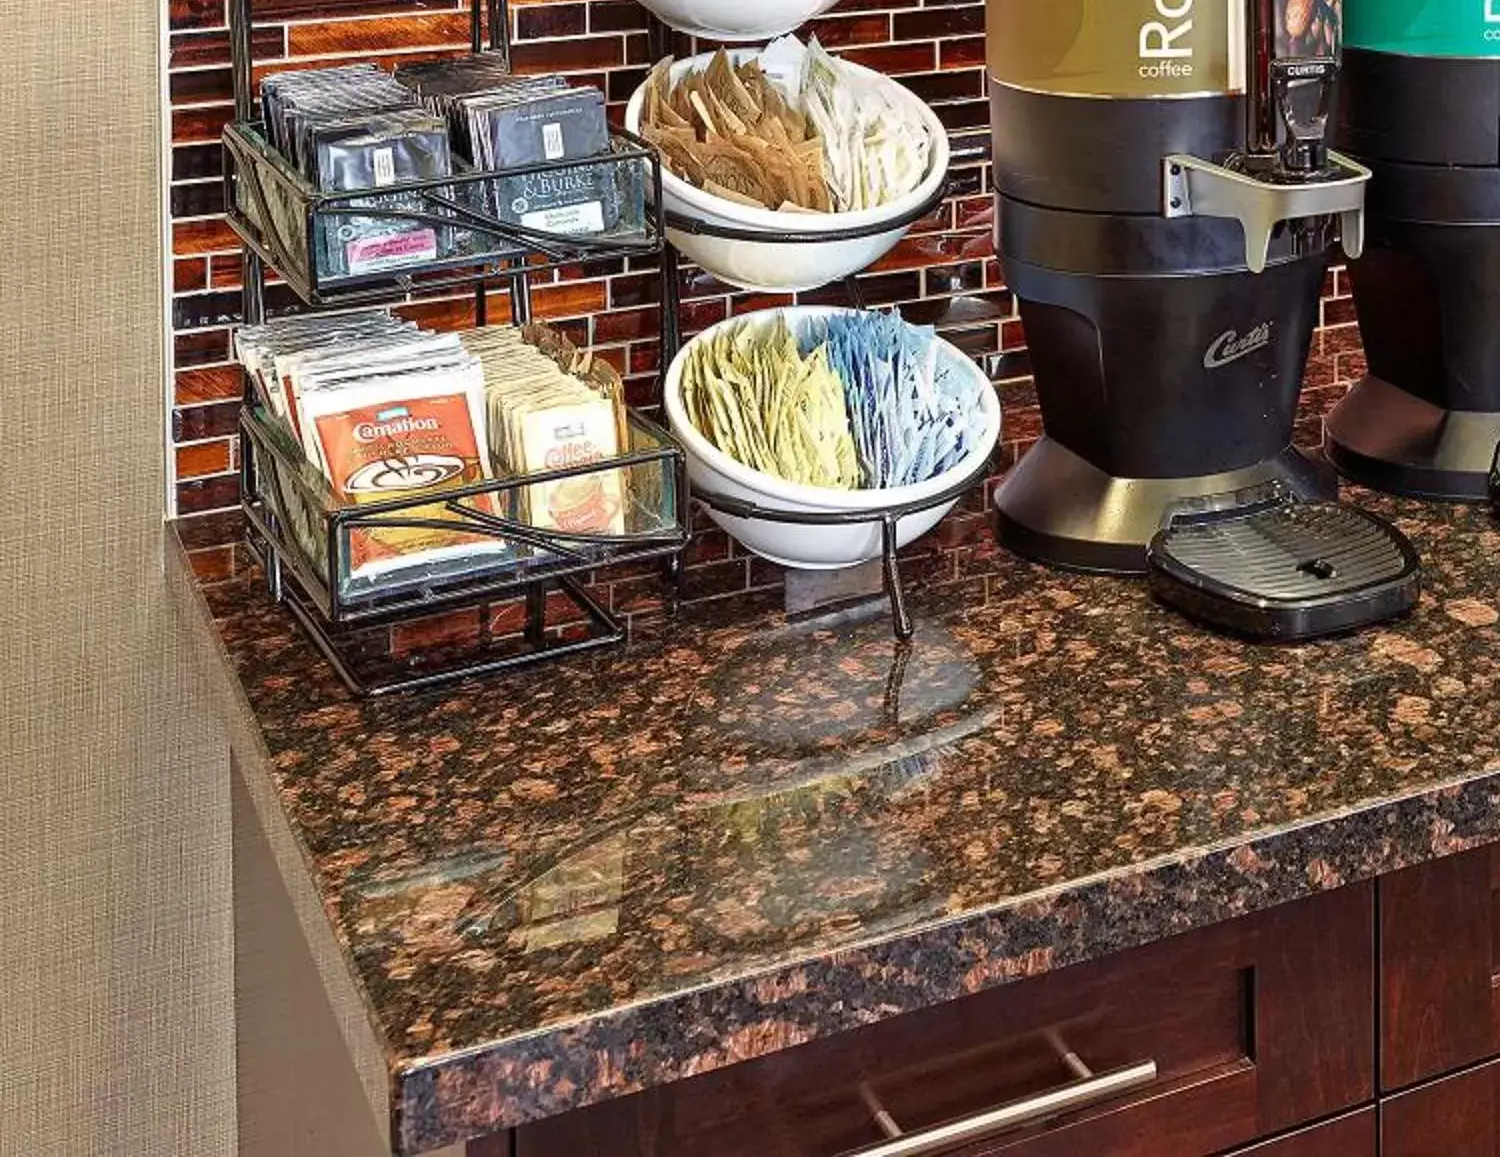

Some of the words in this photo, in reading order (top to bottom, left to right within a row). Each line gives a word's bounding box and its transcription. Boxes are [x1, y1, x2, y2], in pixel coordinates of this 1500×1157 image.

[1138, 59, 1194, 80] coffee
[1287, 63, 1326, 77] CURTIS
[1203, 321, 1271, 368] Curtis
